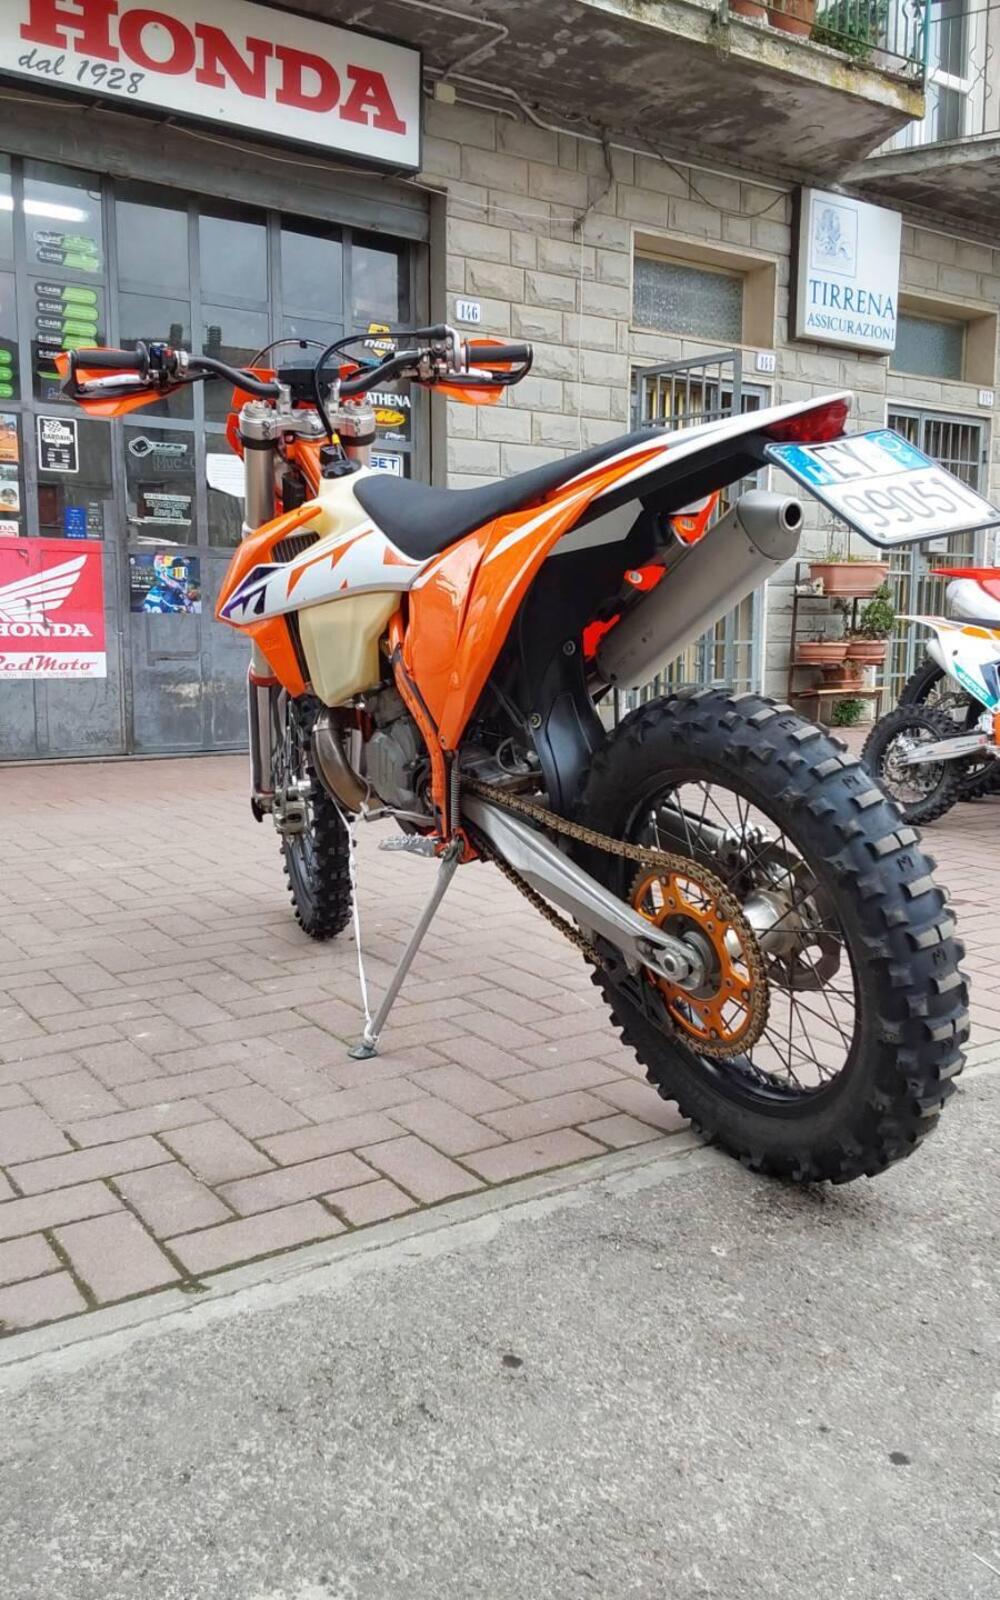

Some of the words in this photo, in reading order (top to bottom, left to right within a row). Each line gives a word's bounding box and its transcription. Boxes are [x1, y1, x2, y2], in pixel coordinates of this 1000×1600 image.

[18, 48, 66, 76] dal
[76, 59, 145, 94] 1928
[19, 0, 406, 136] HONDA
[809, 279, 895, 321] TIRRENA
[807, 311, 895, 342] ASSICURAZIONI
[366, 392, 411, 408] ATHENA
[808, 442, 878, 479] EY
[842, 476, 977, 528] 99051
